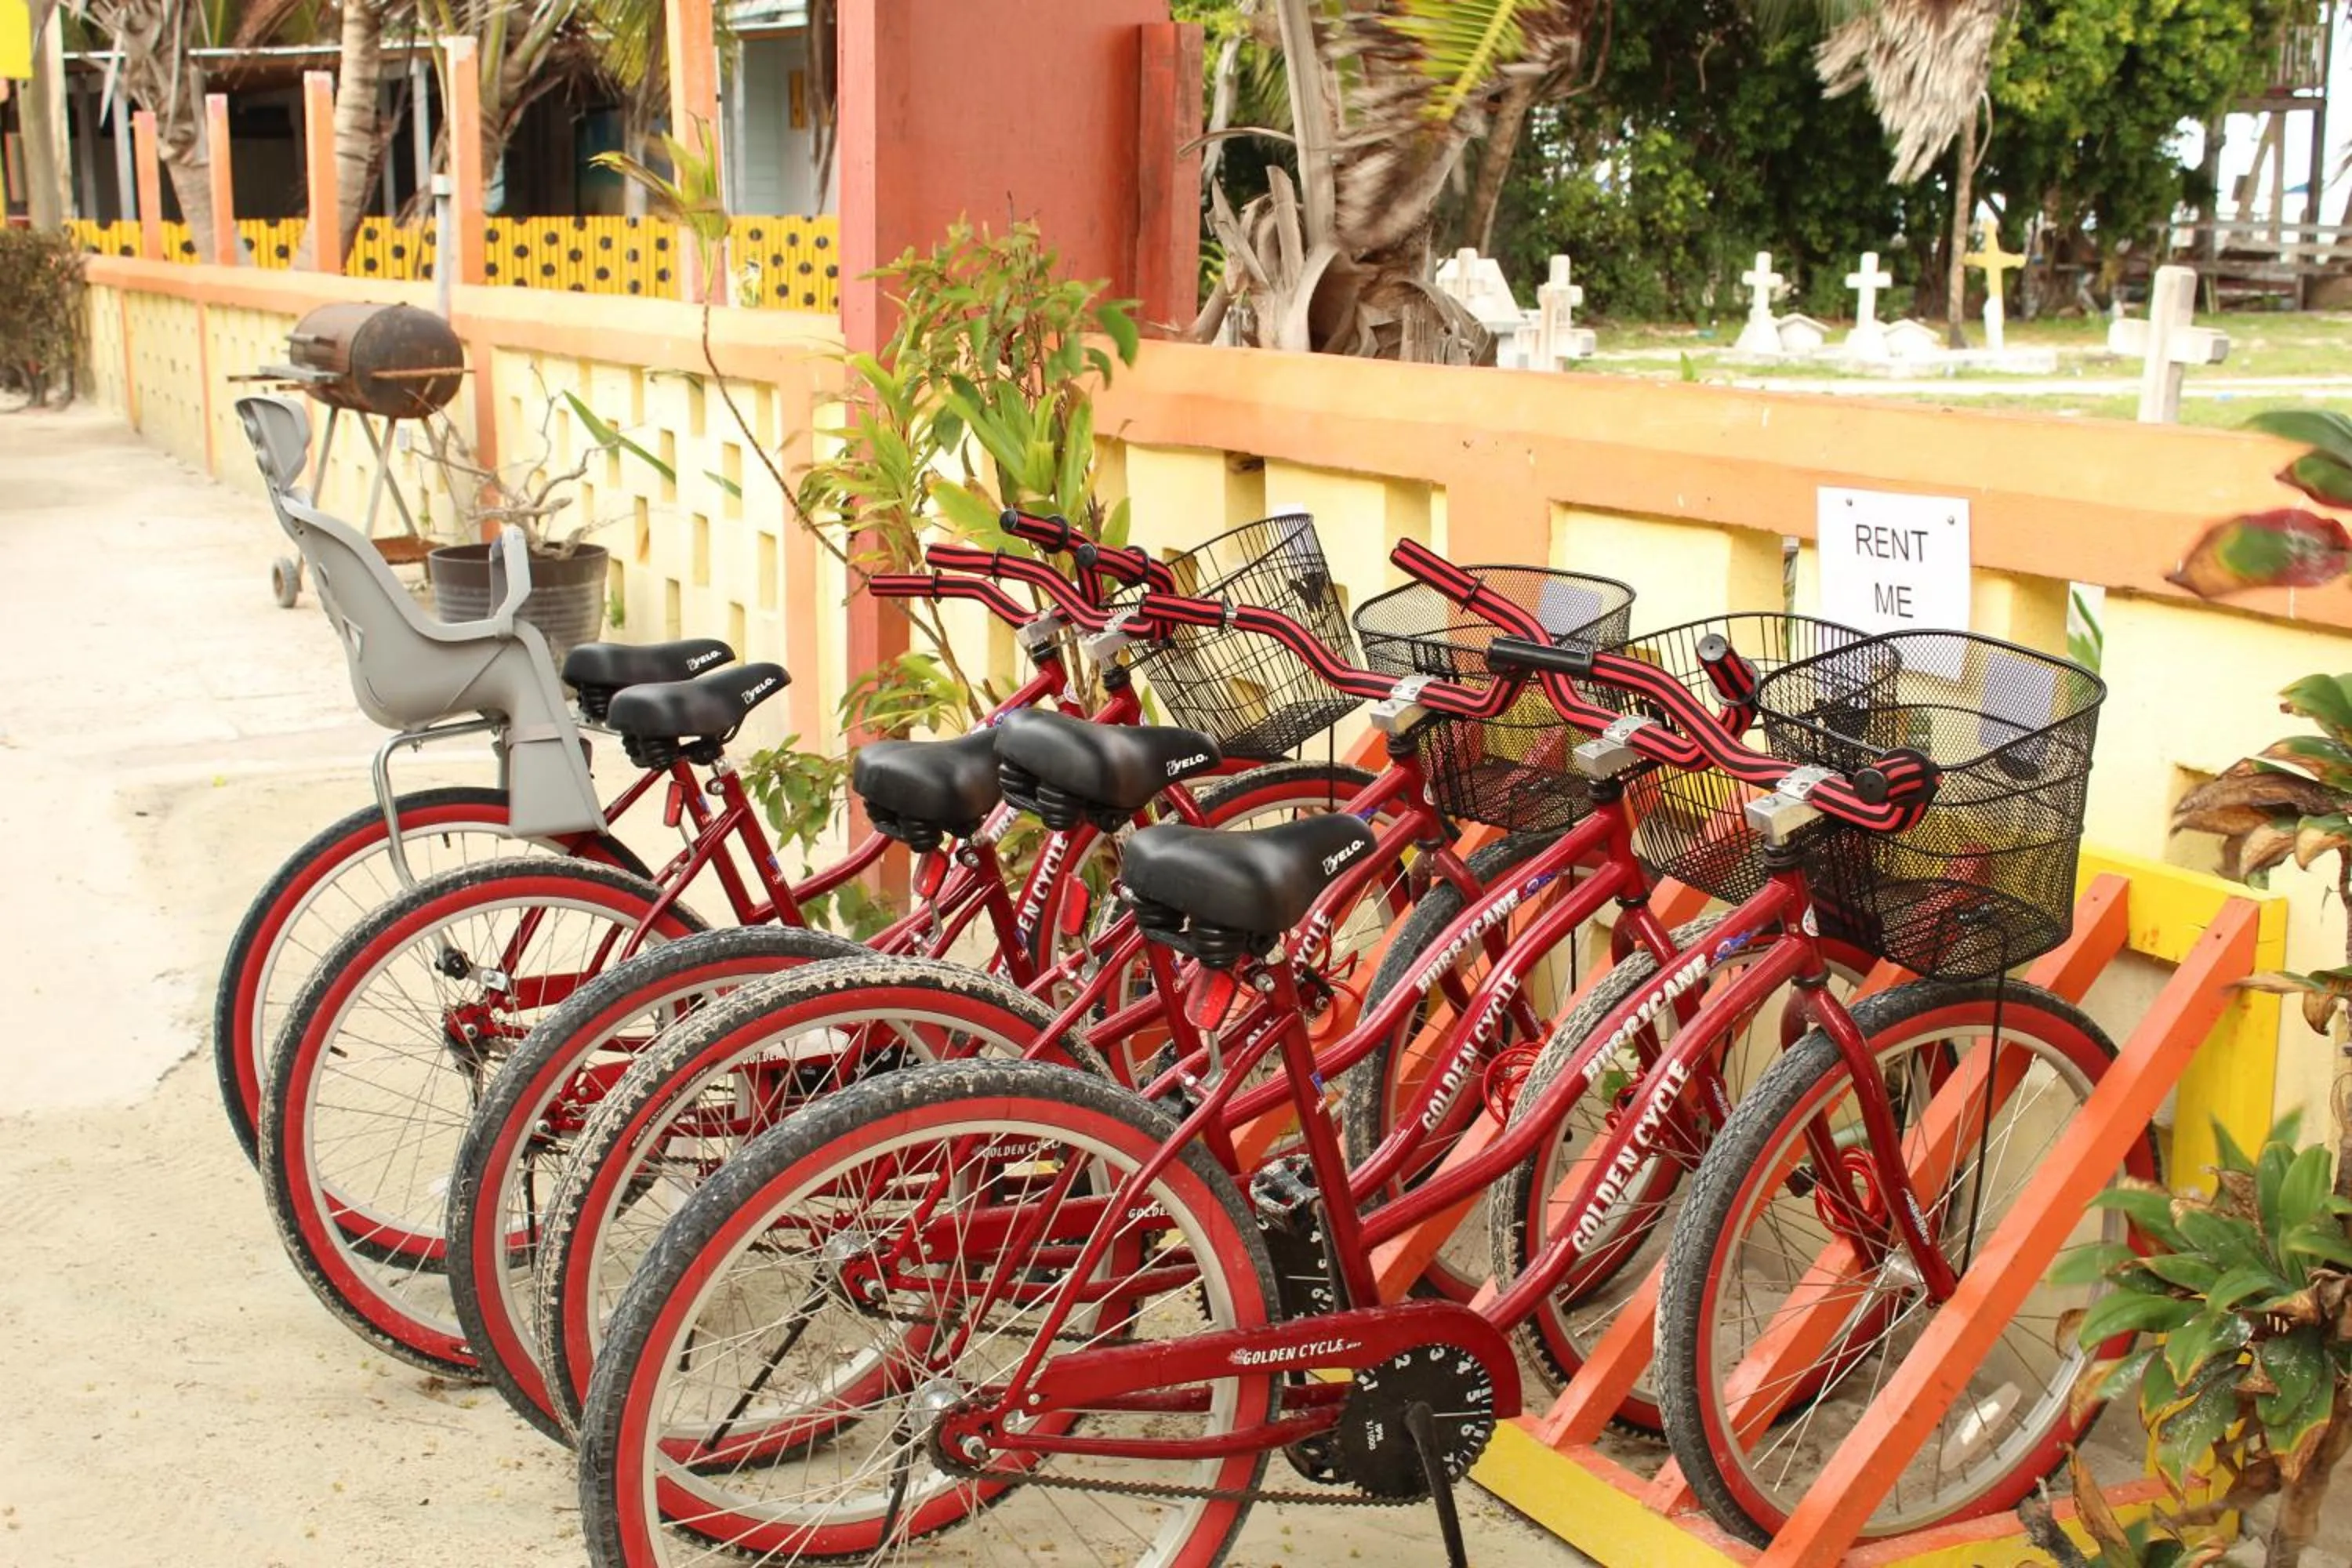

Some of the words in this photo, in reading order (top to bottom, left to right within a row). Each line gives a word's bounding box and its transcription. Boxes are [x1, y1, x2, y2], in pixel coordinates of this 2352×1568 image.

[1856, 524, 1929, 562] RENT
[1875, 583, 1914, 618] ME
[1166, 753, 1208, 777] VELO
[1032, 831, 1069, 899] CYCLE
[1322, 840, 1365, 877] VELO
[1415, 887, 1519, 994] HURRICANE
[1581, 953, 1708, 1083] HURRICANE
[1421, 1040, 1478, 1131] GOLDEN
[1474, 967, 1521, 1044] CYCLE
[1571, 1144, 1640, 1253] GOLDEN
[1633, 1058, 1691, 1148] CYCLE
[1128, 1207, 1171, 1220] GOLDE
[1243, 1346, 1296, 1366] GOLDEN
[1298, 1338, 1345, 1358] CYCLE
[1394, 1353, 1411, 1370] 2
[1428, 1346, 1446, 1361] 3
[1456, 1359, 1472, 1375] 4
[1465, 1388, 1482, 1403] 5
[1460, 1423, 1476, 1436] 6
